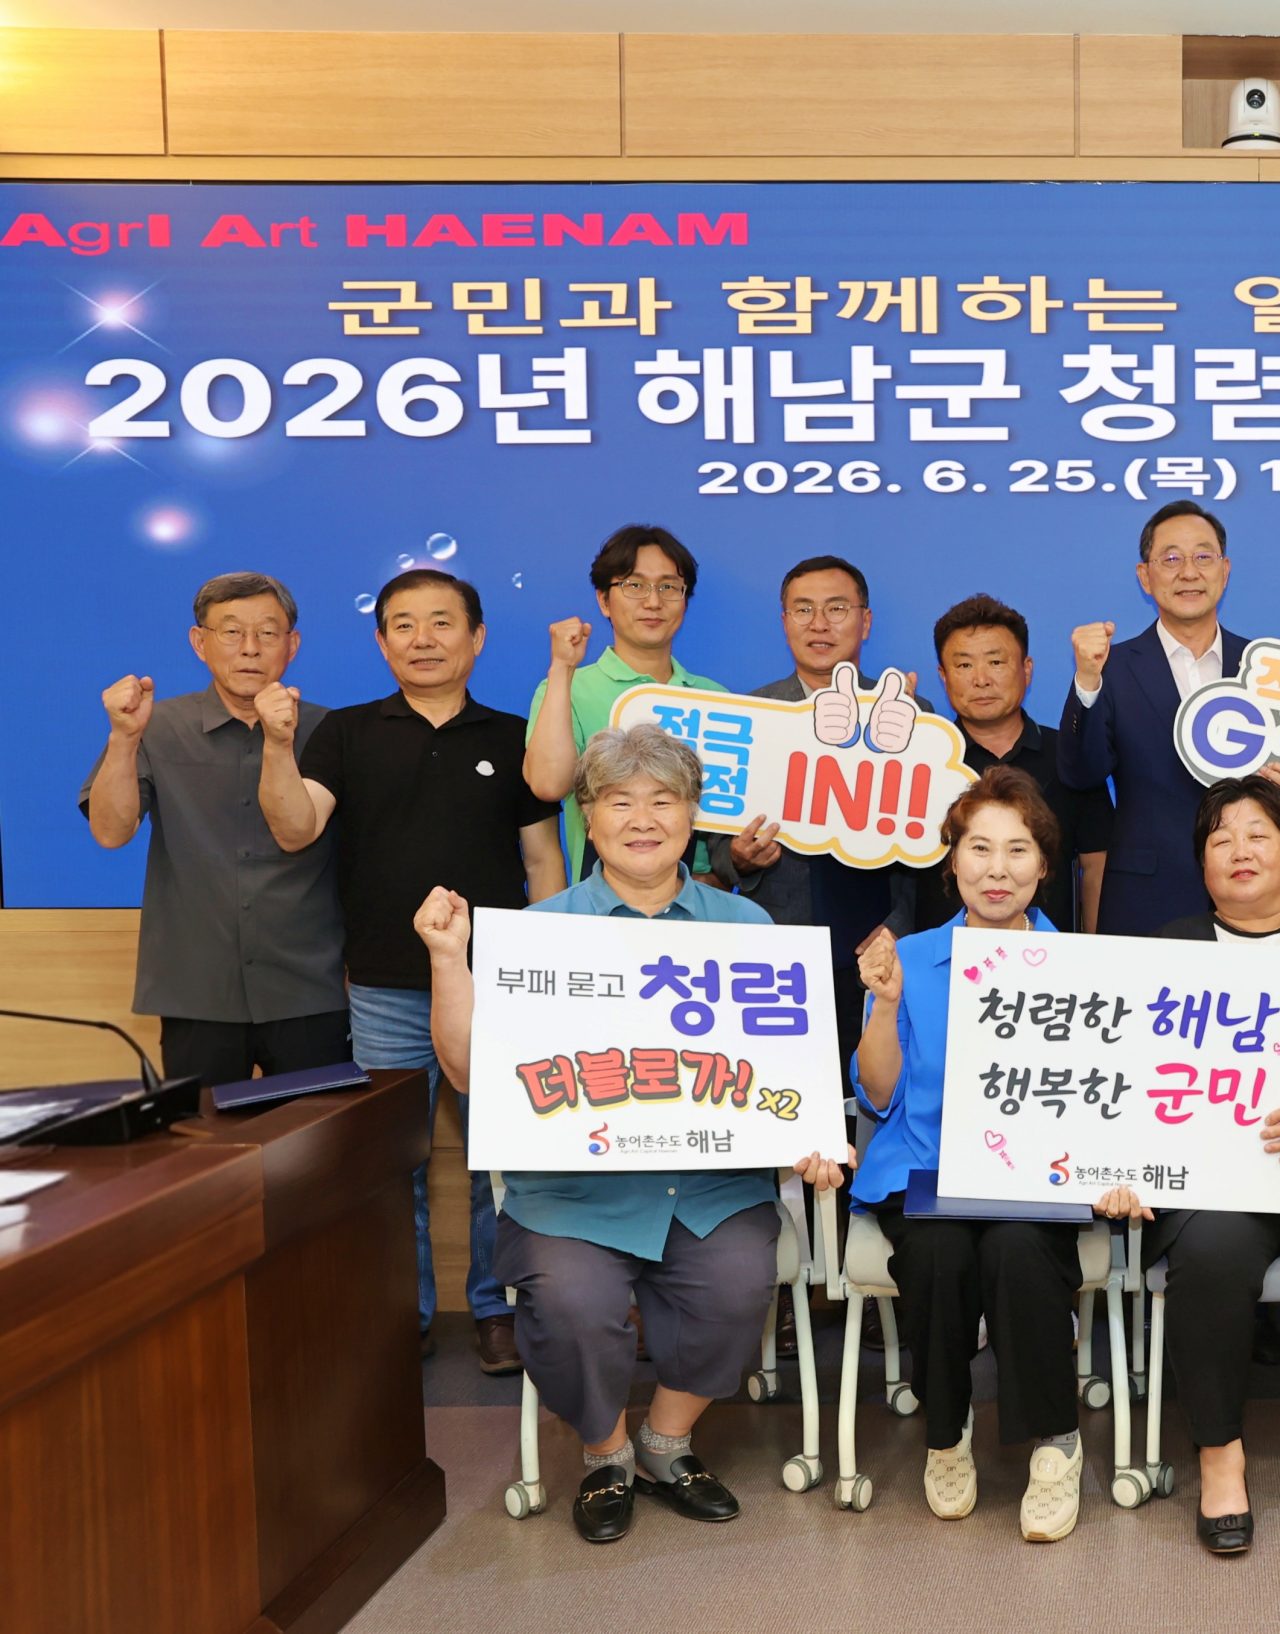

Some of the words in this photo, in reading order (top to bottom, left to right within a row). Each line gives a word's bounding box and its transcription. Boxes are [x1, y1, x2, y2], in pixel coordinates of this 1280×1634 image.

[202, 215, 317, 247] Art
[347, 214, 747, 246] HAENAM
[329, 278, 671, 335] 군민과
[722, 276, 1176, 333] 함께하는
[85, 347, 592, 445] 2026년
[635, 346, 1020, 443] 해남군
[699, 461, 900, 493] 2026.
[924, 461, 986, 492] 6.
[1010, 458, 1236, 499] 25.(목)
[653, 705, 753, 766] 적극
[700, 764, 748, 816] 정
[784, 752, 930, 839] IN!!
[496, 967, 556, 995] 부패
[567, 971, 625, 998] 묻고
[640, 956, 808, 1036] 청렴
[978, 988, 1132, 1044] 청렴한
[1148, 988, 1280, 1052] 해남
[516, 1048, 754, 1116] 더블로가!
[979, 1063, 1131, 1119] 행복한
[1146, 1062, 1266, 1126] 군민
[616, 1134, 682, 1148] 농어촌수도
[687, 1130, 734, 1153] 해남
[1075, 1165, 1138, 1181] 농어촌수도
[1143, 1165, 1189, 1190] 해남
